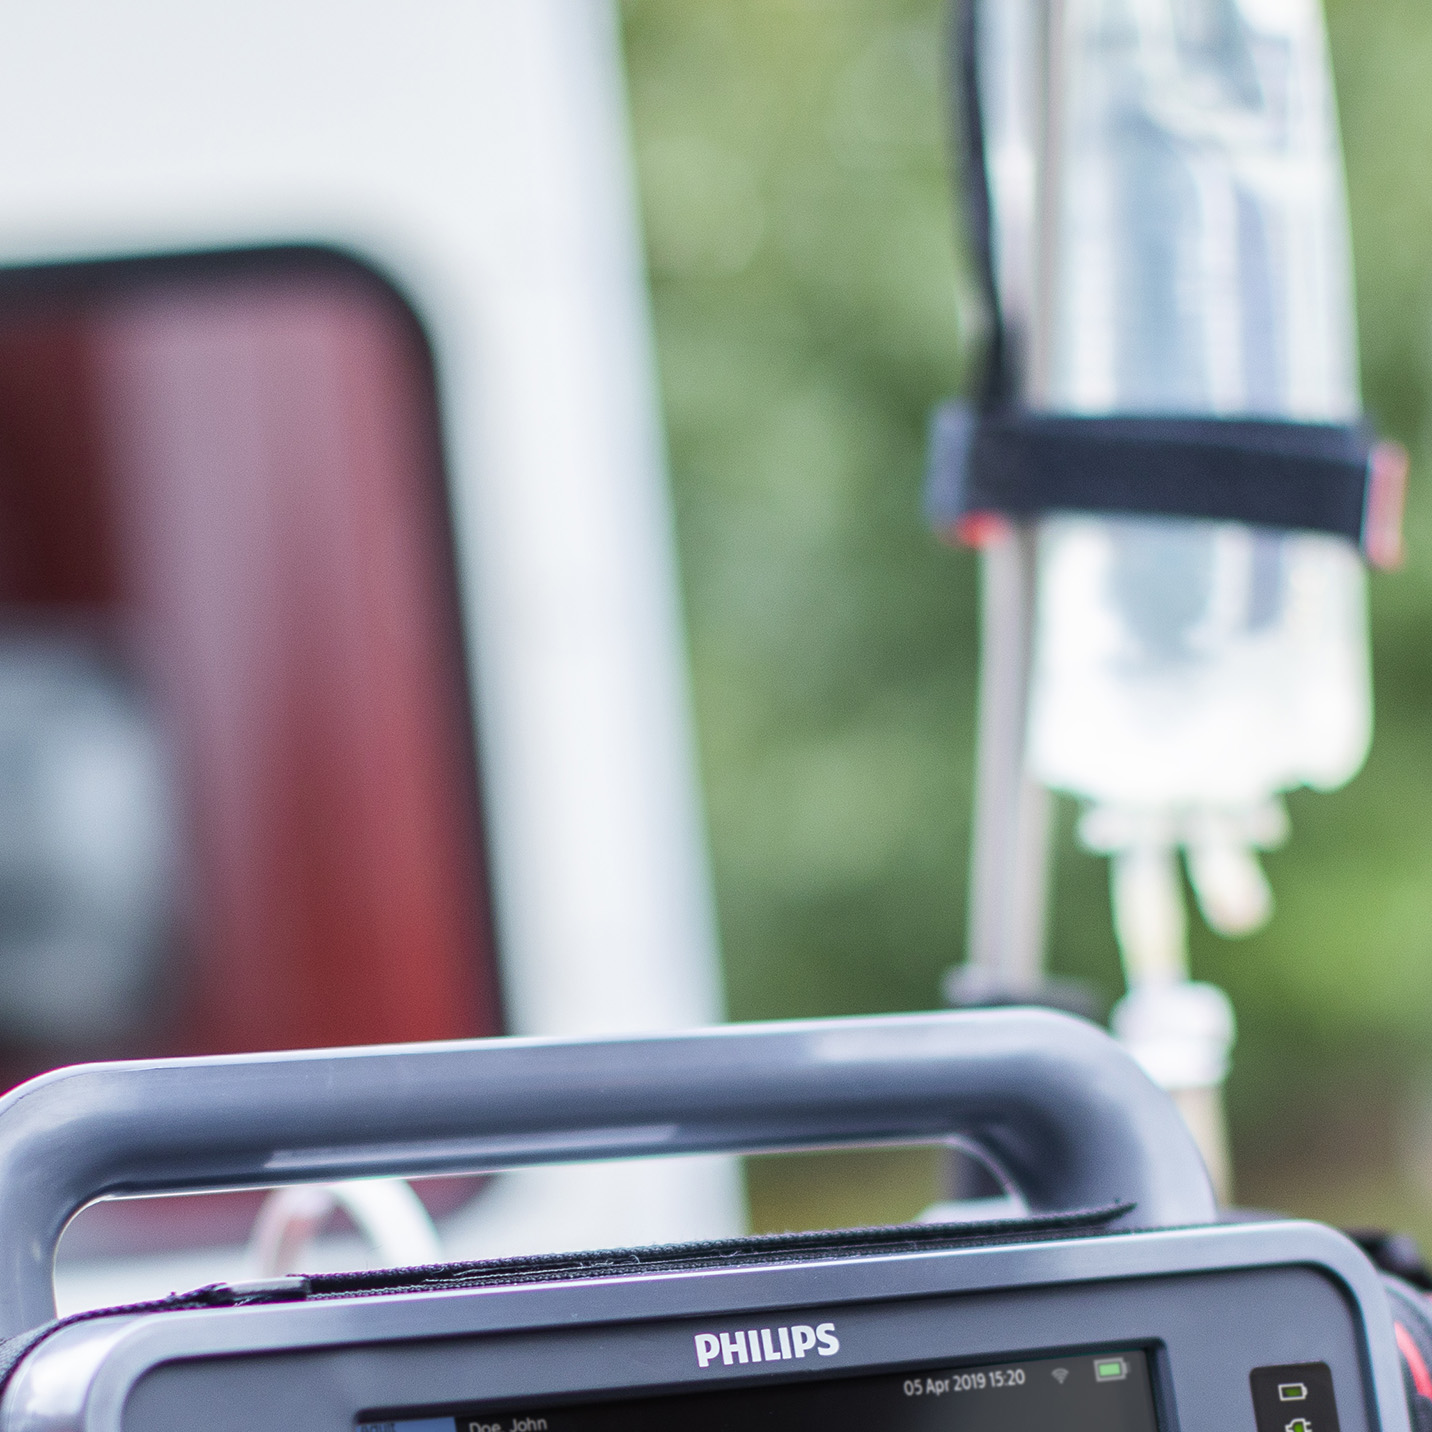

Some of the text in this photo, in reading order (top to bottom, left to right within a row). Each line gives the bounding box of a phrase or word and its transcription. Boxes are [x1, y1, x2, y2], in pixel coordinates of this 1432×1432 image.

[694, 1323, 840, 1367] PHILIPS
[903, 1369, 1026, 1396] 05 Apr 2019 15:20
